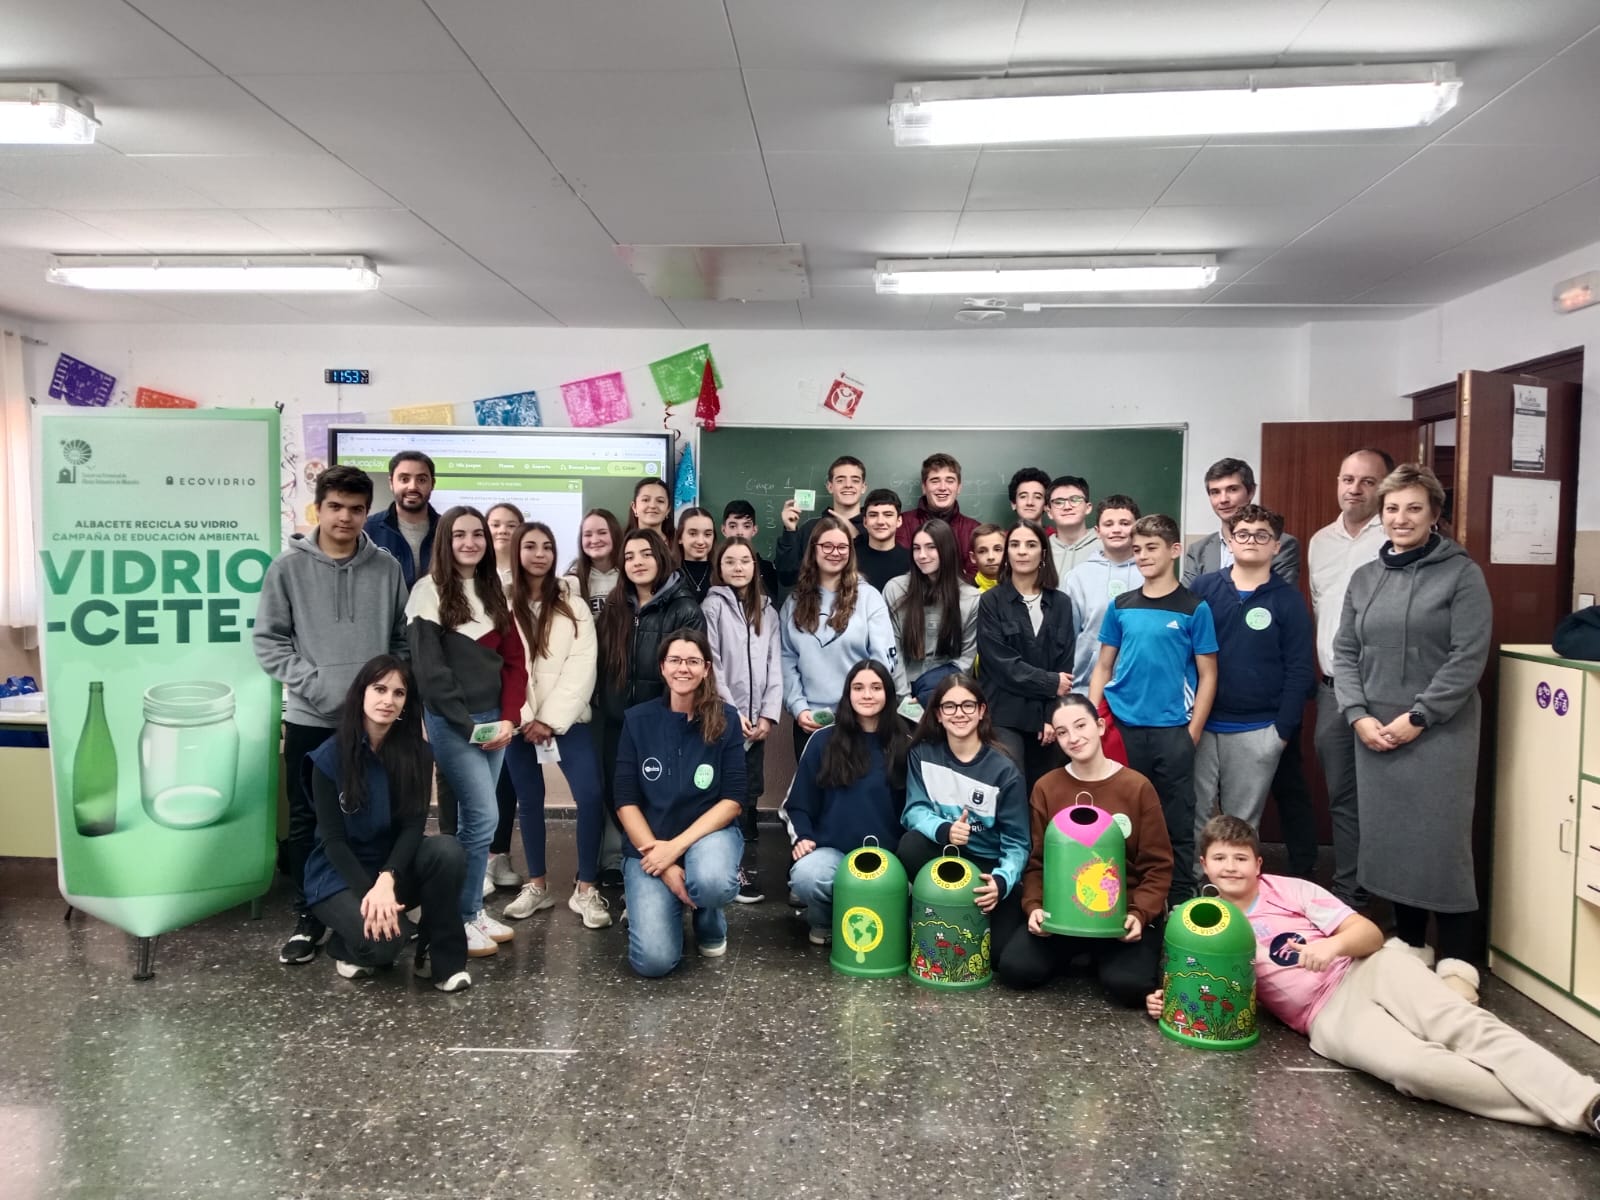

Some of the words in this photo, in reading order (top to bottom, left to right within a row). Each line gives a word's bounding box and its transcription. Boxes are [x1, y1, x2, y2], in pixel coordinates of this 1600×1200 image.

[179, 477, 256, 486] ECOVIDRIO
[75, 520, 132, 529] ALBACETE
[135, 520, 181, 529] RECICLA
[184, 520, 198, 528] SU
[201, 520, 238, 528] VIDRIO
[52, 532, 110, 541] CAMPAÑA
[114, 533, 128, 541] DE
[131, 532, 196, 541] EDUCACIÓN
[199, 533, 260, 541] AMBIENTAL
[39, 548, 273, 595] VIDRIO
